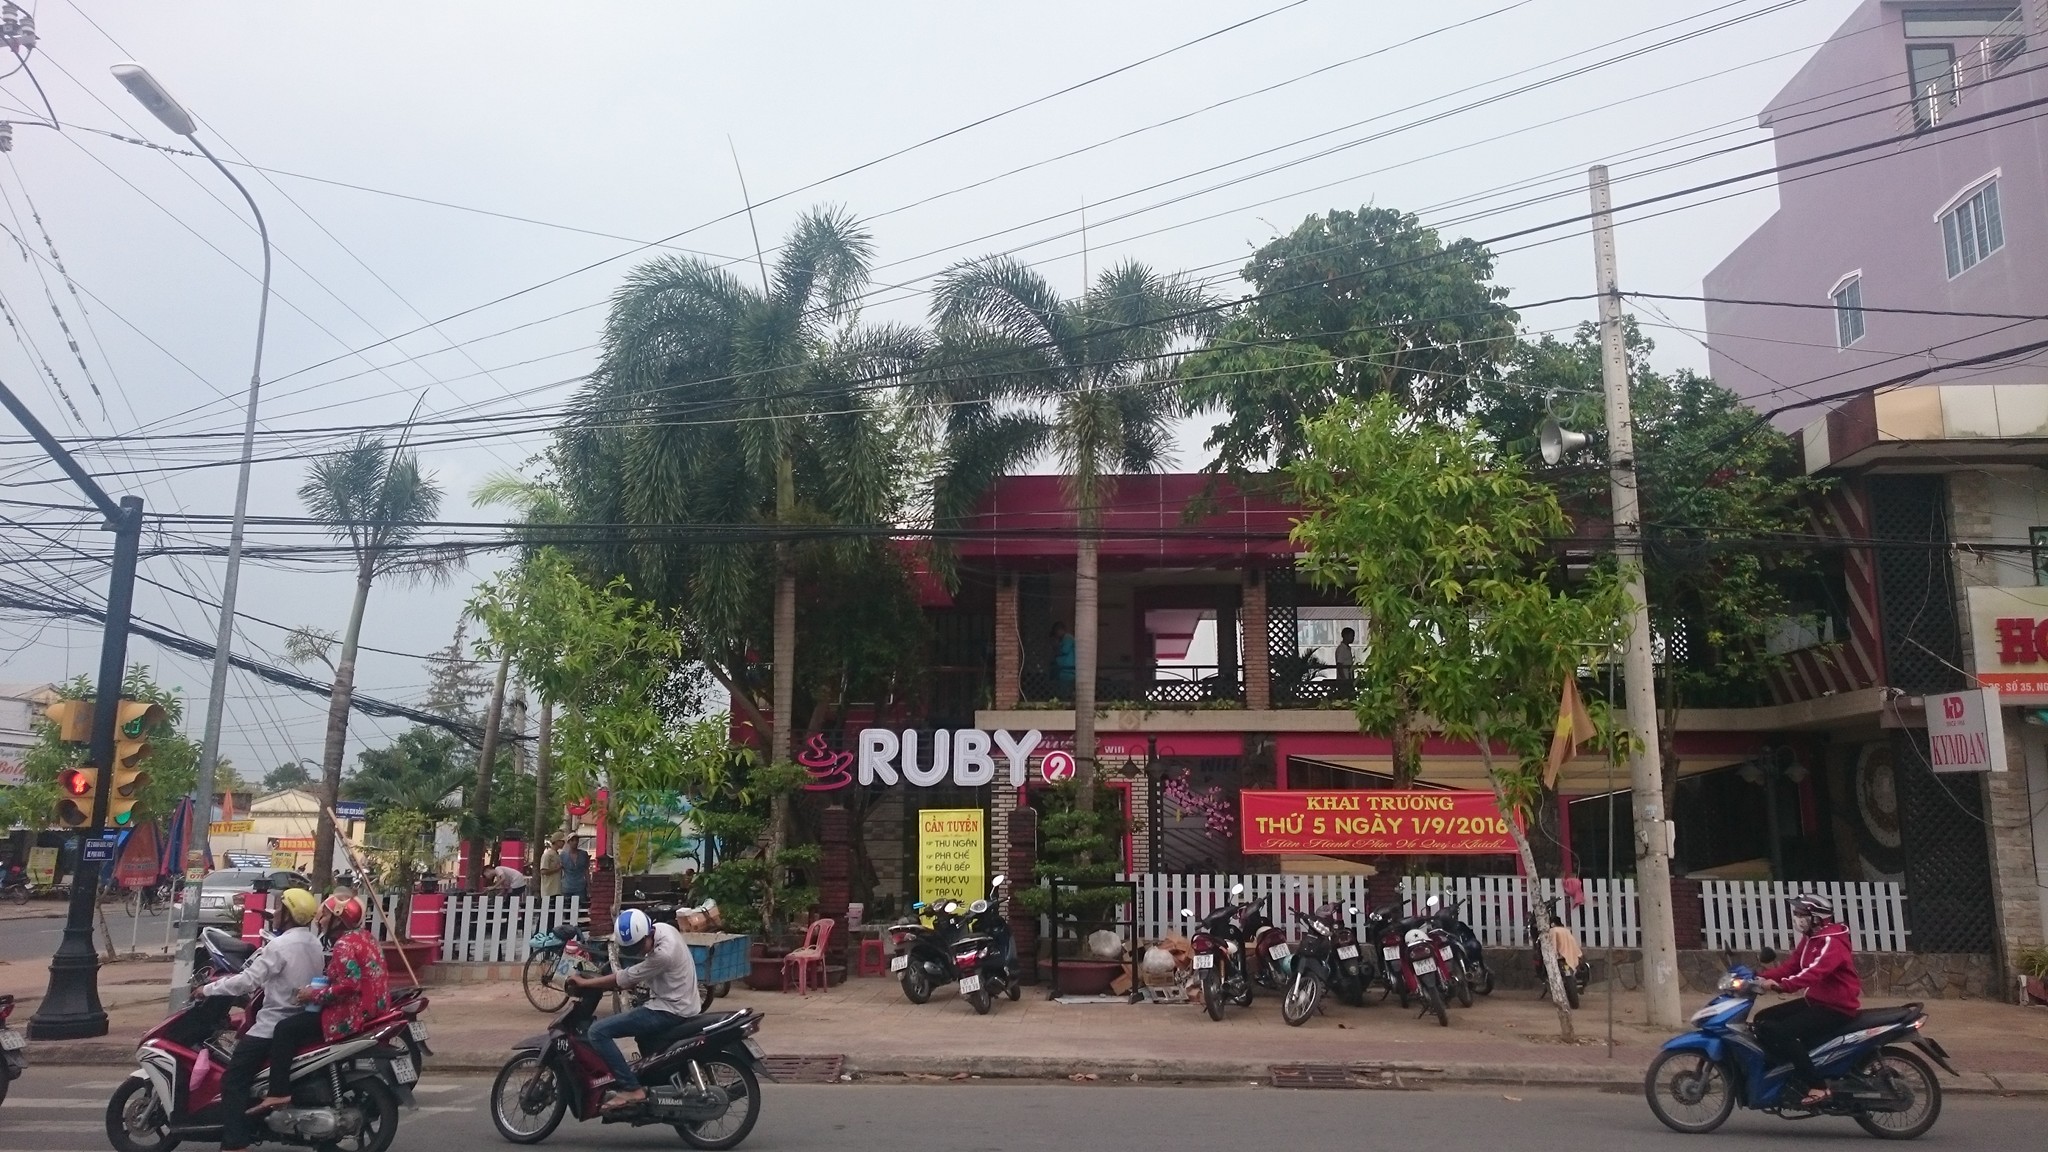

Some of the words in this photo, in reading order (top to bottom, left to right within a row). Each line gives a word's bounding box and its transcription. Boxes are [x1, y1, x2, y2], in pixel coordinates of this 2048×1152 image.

[858, 728, 1041, 787] RUBY
[1931, 732, 1987, 766] KYMDAN
[1306, 796, 1360, 811] KHAI
[1366, 794, 1455, 811] TRƯƠNG
[925, 815, 944, 832] CẦN
[947, 814, 978, 832] TUYỂN
[1255, 812, 1305, 835] THỨ
[1312, 817, 1326, 835] 5
[1335, 812, 1403, 835] NGÀY
[1411, 817, 1509, 835] 1/9/2016
[935, 840, 950, 848] THU
[952, 838, 977, 848] NGÂN
[935, 852, 951, 860] PHA
[935, 876, 956, 885] PHỤC
[658, 1098, 683, 1106] YAMAHA
